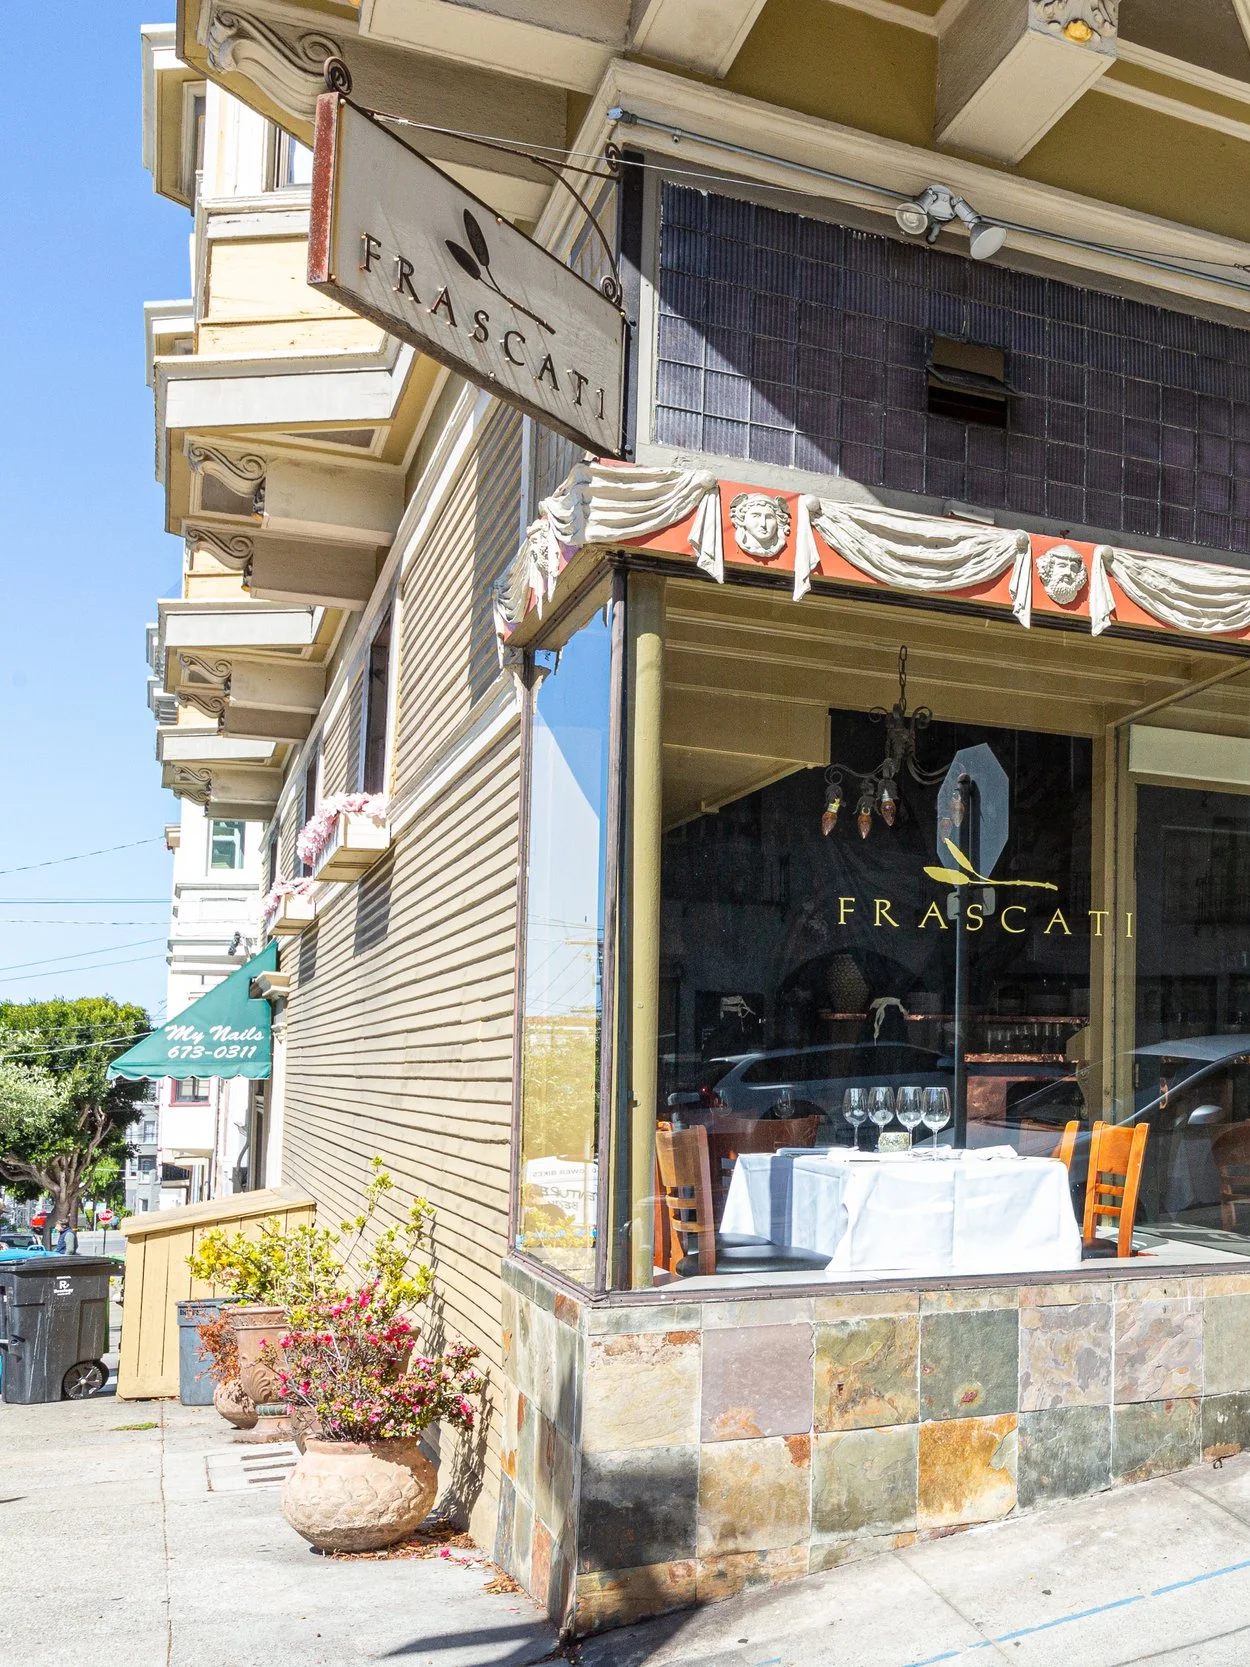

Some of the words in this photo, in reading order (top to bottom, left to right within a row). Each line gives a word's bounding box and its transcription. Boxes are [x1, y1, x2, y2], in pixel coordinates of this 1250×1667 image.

[359, 231, 605, 420] FRASCATI
[837, 896, 1136, 938] FRASCATI
[164, 1024, 205, 1045] My
[209, 1025, 264, 1042] Nails
[167, 1045, 258, 1059] 673-0311
